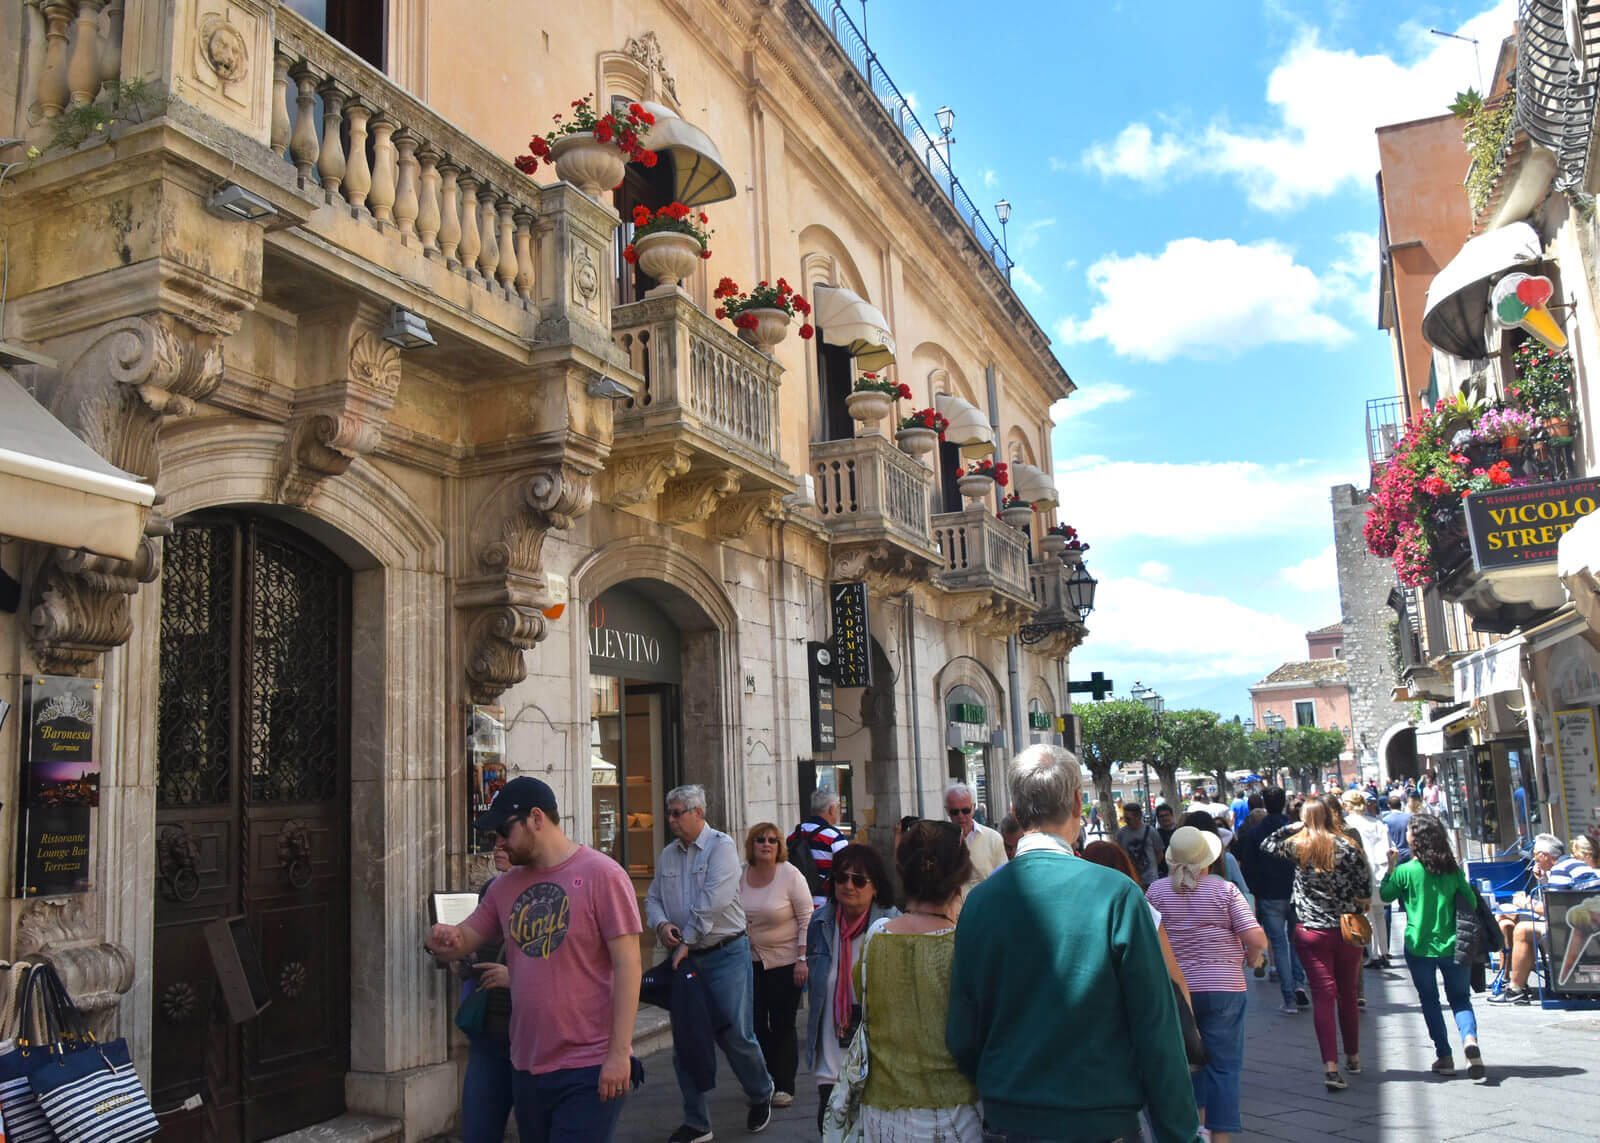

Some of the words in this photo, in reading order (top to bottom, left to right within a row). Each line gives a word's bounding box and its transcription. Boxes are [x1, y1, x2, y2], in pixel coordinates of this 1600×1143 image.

[1486, 490, 1545, 504] Ristorante
[1548, 486, 1566, 497] dal
[1488, 497, 1596, 526] VICOLO
[1487, 523, 1575, 550] STRET
[1523, 548, 1558, 559] Terra
[844, 595, 856, 685] TAORMINA
[853, 584, 866, 684] RISTORANTE
[835, 606, 846, 686] PIZZERIA
[41, 725, 91, 740] Baronessa
[41, 833, 86, 845] Ristorante
[37, 847, 70, 860] Lounge
[72, 846, 88, 857] Bar
[44, 860, 80, 872] Terrazza
[509, 895, 570, 960] Vinyl
